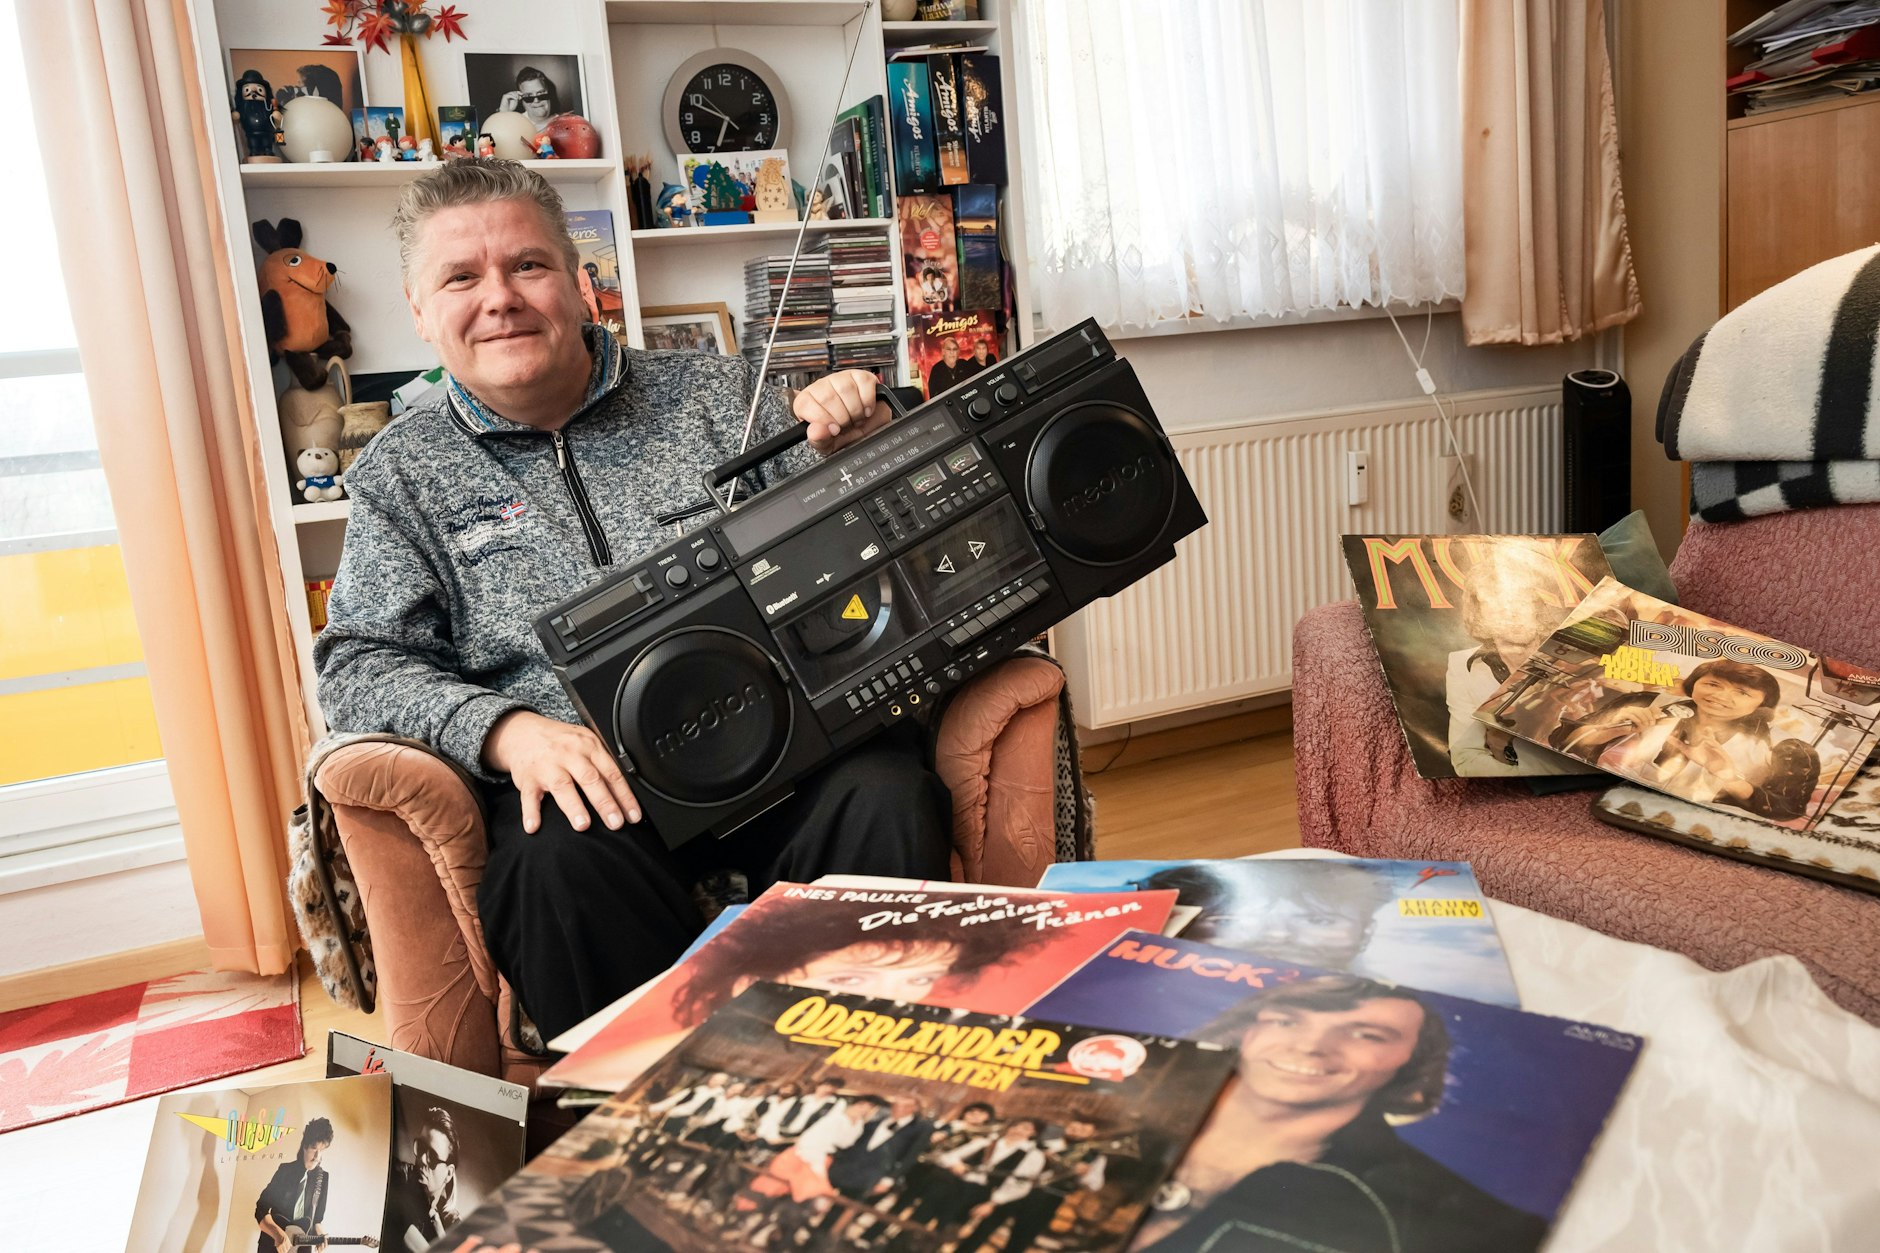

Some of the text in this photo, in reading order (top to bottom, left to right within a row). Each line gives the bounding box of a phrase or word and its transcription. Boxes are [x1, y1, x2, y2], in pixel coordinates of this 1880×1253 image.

[703, 78, 712, 89] 11
[718, 74, 731, 85] 12
[740, 79, 745, 90] 1
[689, 94, 702, 106] 10
[752, 93, 761, 104] 2
[934, 71, 959, 132] Amigos
[901, 78, 924, 140] Amigos
[684, 113, 693, 124] 9
[760, 113, 768, 124] 3
[691, 131, 701, 143] 8
[754, 132, 763, 143] 4
[926, 314, 979, 337] Amigos
[987, 373, 1005, 386] VOLUME
[961, 388, 978, 400] TUNING
[853, 457, 863, 466] 92
[866, 451, 876, 460] 96
[878, 443, 890, 454] 100
[891, 436, 903, 446] 104
[855, 475, 866, 486] 90
[868, 468, 879, 479] 94
[881, 460, 891, 471] 98
[893, 453, 906, 464] 102
[907, 446, 920, 457] 106
[1063, 455, 1156, 517] medion
[690, 538, 705, 549] BASS
[657, 553, 677, 567] TREBLE
[1361, 537, 1594, 609] MUK
[1628, 619, 1807, 670] DISCO
[1615, 645, 1655, 662] MIT
[655, 684, 765, 758] medion
[784, 887, 927, 904] INES PAULKE
[858, 896, 1009, 931] Die Farbe
[960, 899, 1068, 927] meiner
[1022, 901, 1142, 931] Tränen
[1108, 940, 1274, 988] MUCK
[774, 996, 1061, 1070] ODERLÄNDER
[824, 1042, 1025, 1093] MUSIKANTEN
[498, 1086, 523, 1102] AMIGA
[220, 1152, 285, 1164] LIEBE PUR
